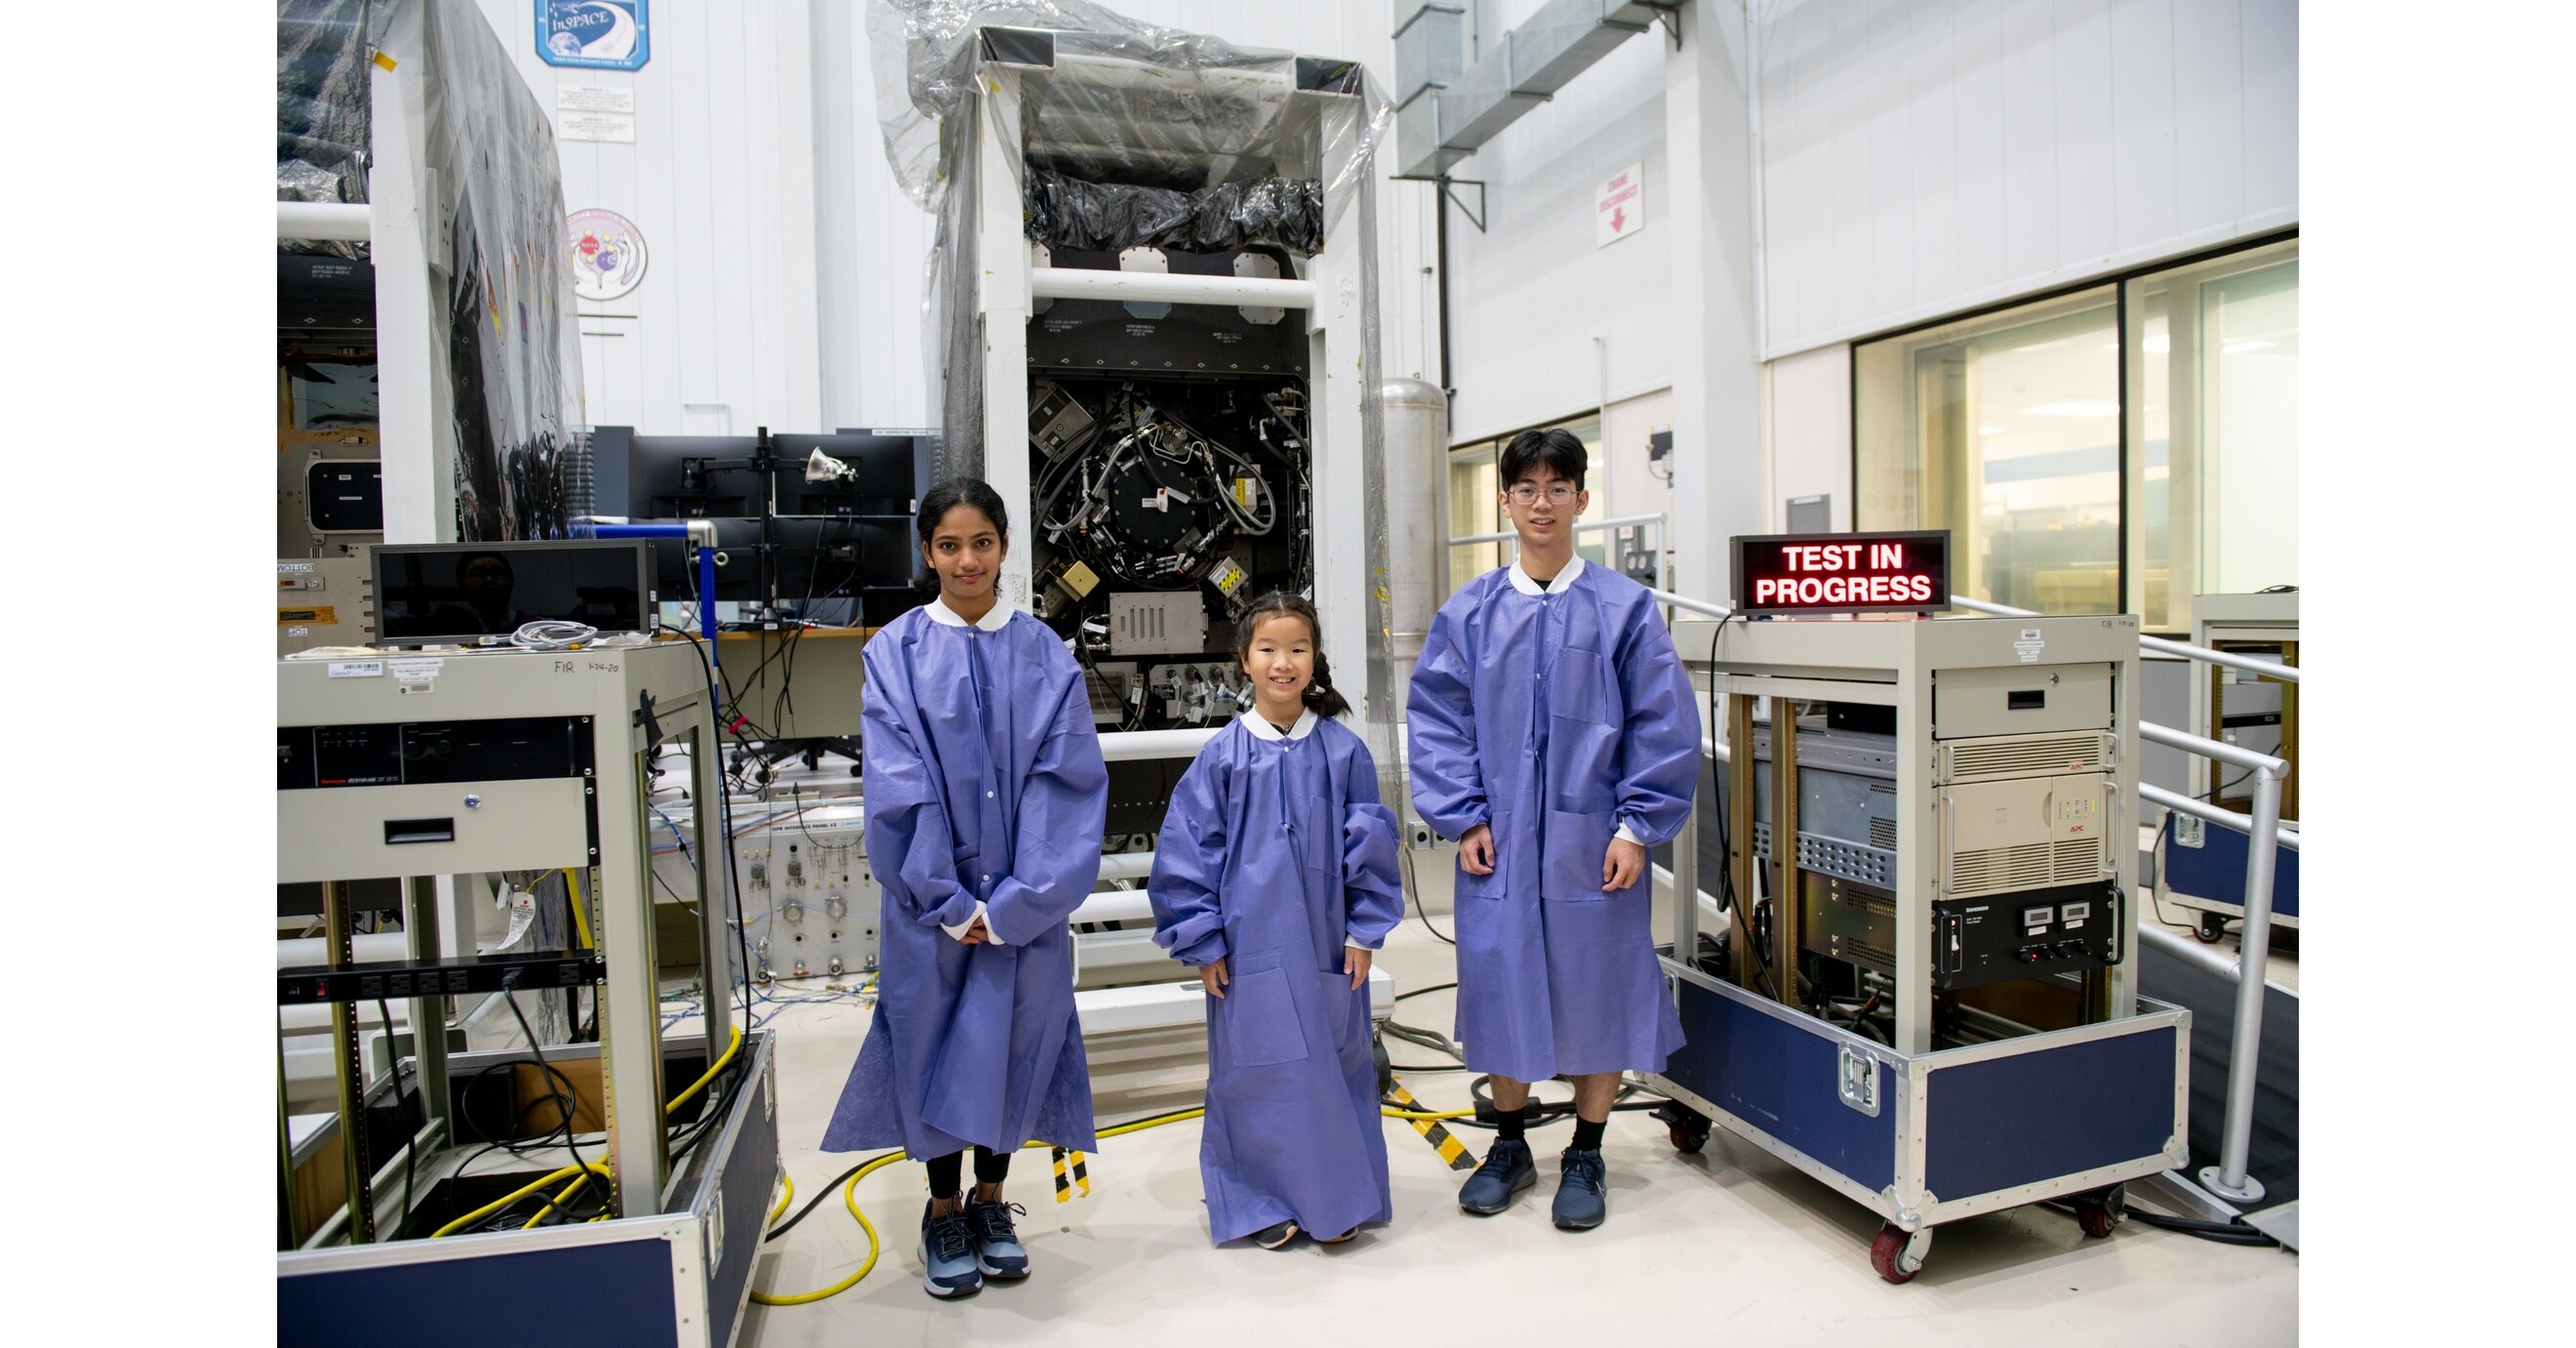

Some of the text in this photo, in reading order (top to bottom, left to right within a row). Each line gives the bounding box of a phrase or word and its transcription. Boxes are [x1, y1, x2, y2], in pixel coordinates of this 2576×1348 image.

[552, 11, 610, 31] InSPACE
[1782, 544, 1902, 571] TEST IN
[1756, 575, 1931, 603] PROGRESS
